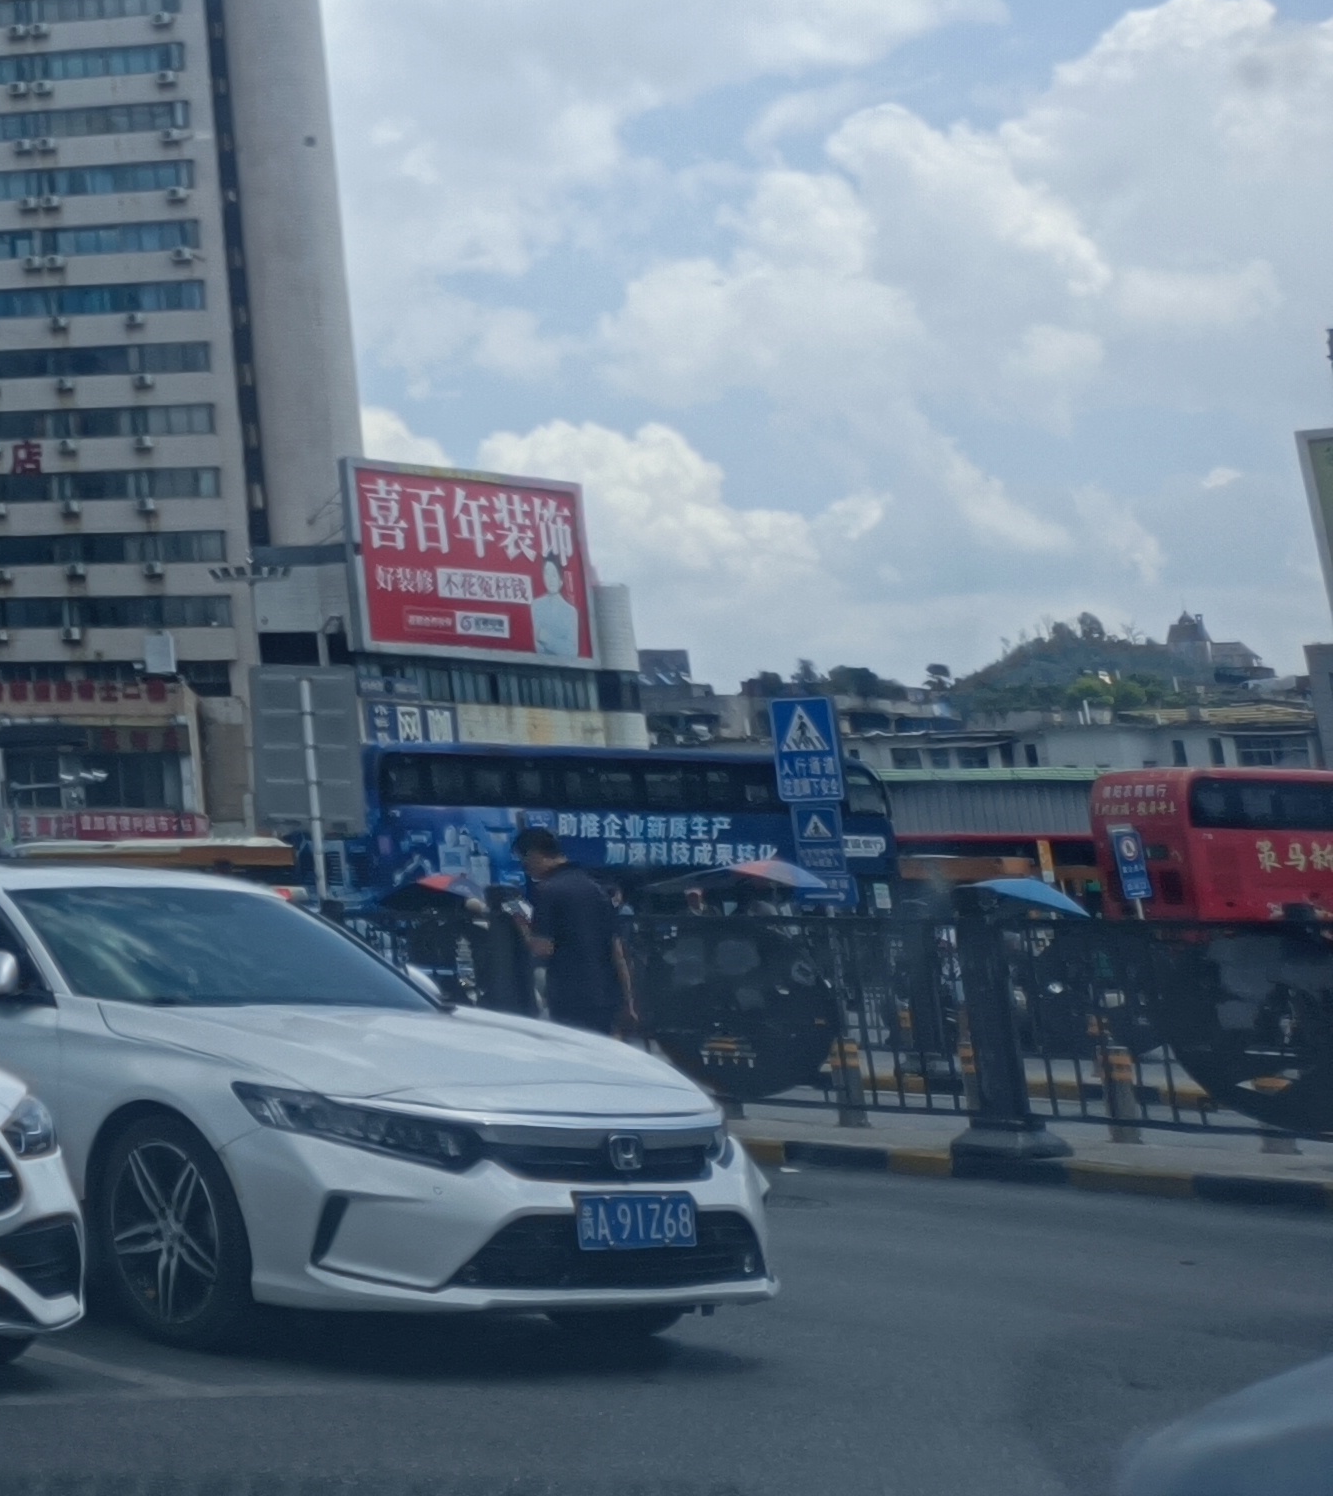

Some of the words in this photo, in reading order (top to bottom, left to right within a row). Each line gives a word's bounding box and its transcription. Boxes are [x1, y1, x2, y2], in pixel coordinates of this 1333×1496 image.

[360, 478, 573, 567] 喜百年装饰
[375, 563, 435, 594] 好装修
[443, 573, 530, 601] 不花冤枉钱
[557, 812, 732, 841] 助推企业新质生产
[605, 841, 778, 867] 加速科技成果转化
